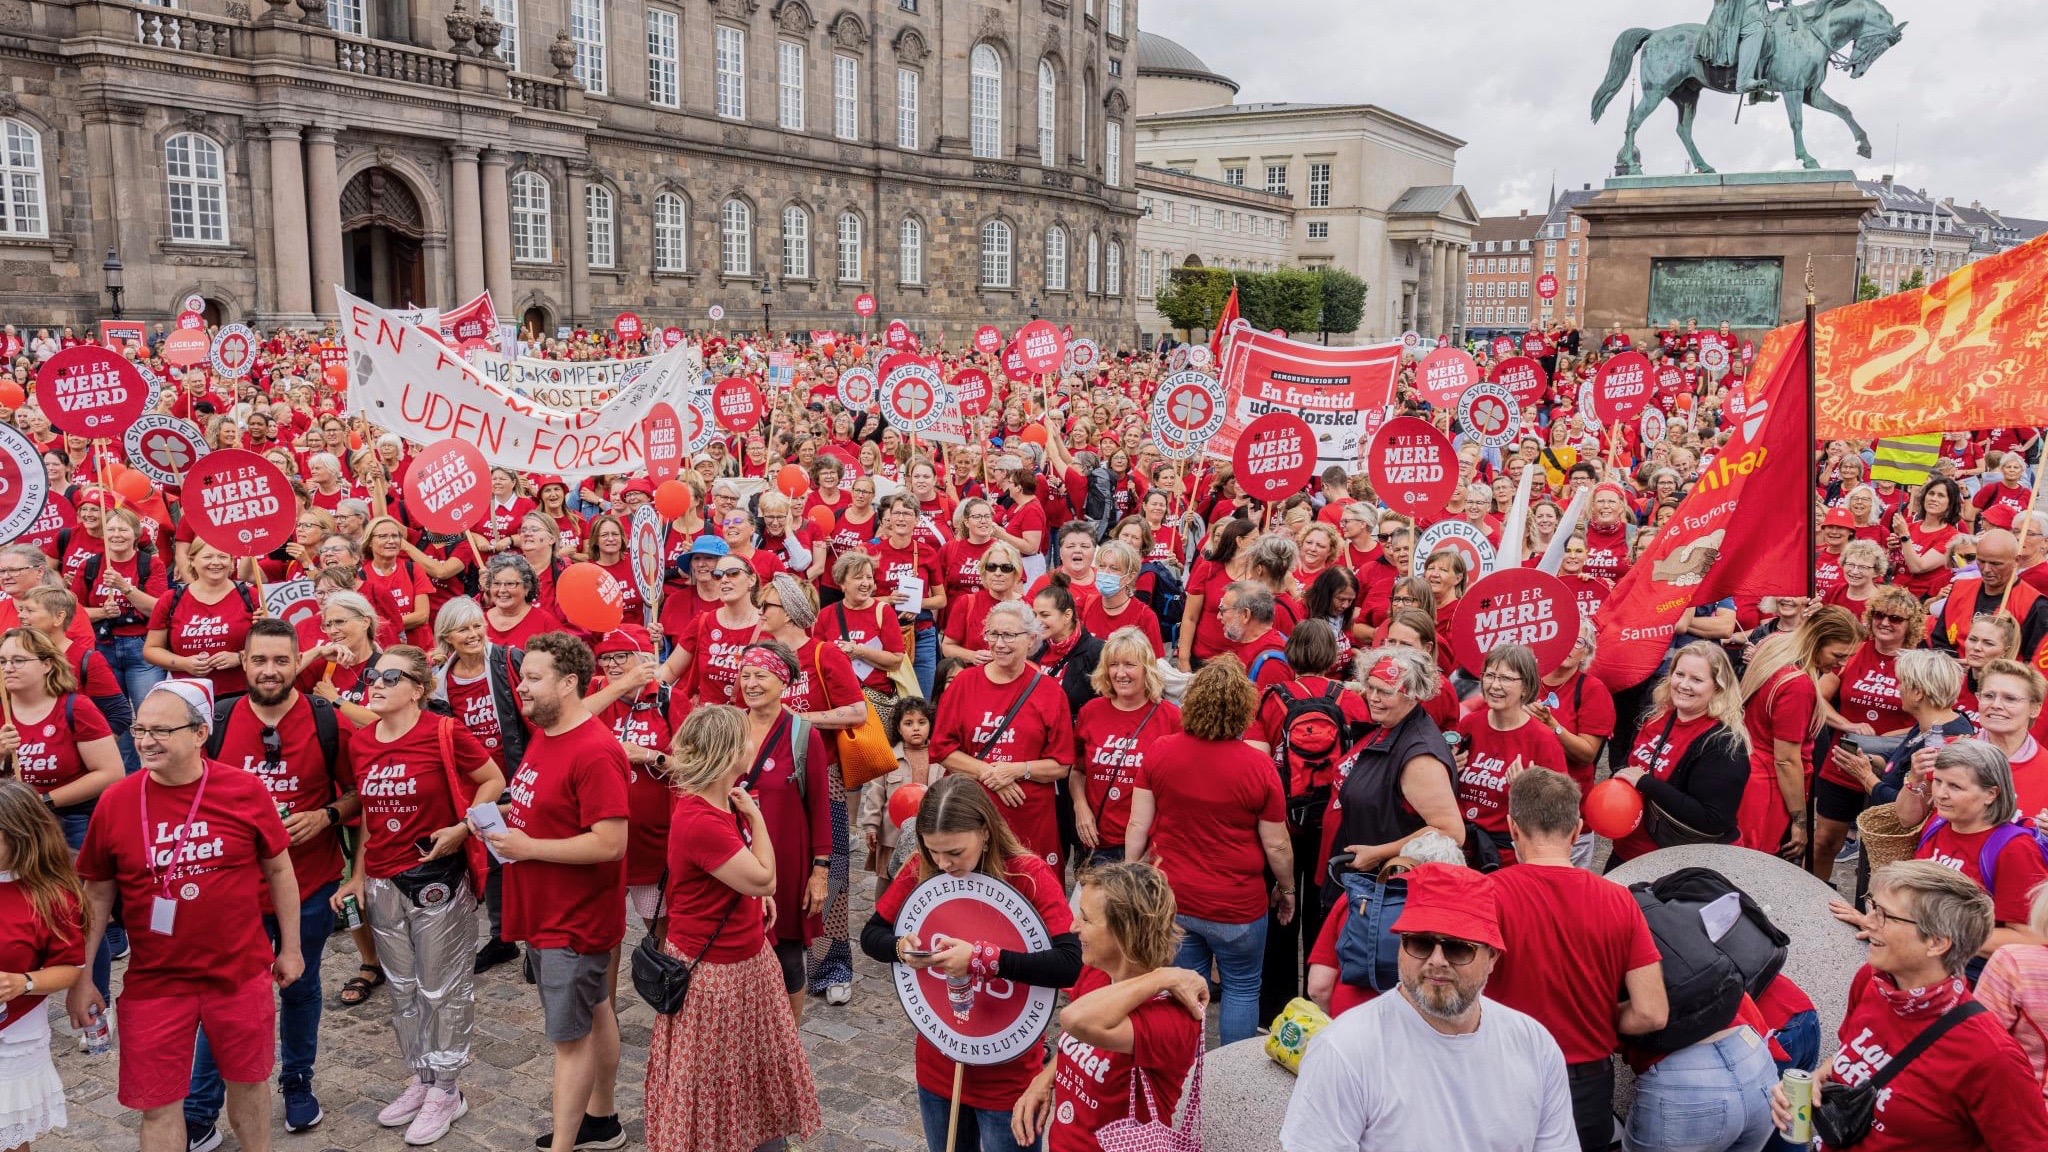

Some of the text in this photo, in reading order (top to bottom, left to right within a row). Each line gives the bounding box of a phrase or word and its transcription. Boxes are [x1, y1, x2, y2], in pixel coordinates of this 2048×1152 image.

[214, 324, 254, 350] SYGEPLEJE
[352, 305, 405, 354] EN
[1025, 334, 1055, 350] MERE
[1027, 344, 1058, 358] VÆRD
[322, 351, 335, 359] ER
[92, 361, 111, 371] ER
[484, 360, 526, 383] HØJ
[1427, 364, 1465, 380] MERE
[1629, 363, 1640, 372] ER
[55, 370, 121, 395] MERE
[1273, 373, 1334, 384] DEMONSTRATION
[1427, 376, 1468, 392] VÆRD
[1500, 369, 1534, 384] MERE
[1605, 370, 1643, 388] MERE
[957, 381, 984, 394] MERE
[957, 389, 986, 401] VÆRD
[1260, 382, 1354, 409] En fremtid
[1604, 383, 1644, 399] VÆRD
[57, 387, 128, 412] VÆRD
[720, 393, 751, 406] MERE
[882, 367, 944, 430] DANSK SYGEPLEJE RAAD
[1155, 373, 1225, 441] DANSK SYGEPLEJE RAAD
[721, 403, 754, 416] VÆRD
[1298, 410, 1359, 425] forskel
[1459, 385, 1519, 446] DANSK SYGEPLEJE RAAD
[400, 383, 649, 471] UDEN FORSK
[664, 419, 672, 427] ER
[1281, 427, 1296, 437] ER
[128, 417, 205, 449] SYGEPLEJE
[650, 428, 675, 443] MERE
[1416, 435, 1431, 445] ER
[650, 444, 676, 460] VÆRD
[1248, 437, 1302, 459] MERE
[1384, 446, 1440, 465] MERE
[128, 447, 175, 484] DANSK
[442, 450, 457, 465] ER
[1248, 453, 1303, 475] VÆRD
[238, 466, 257, 479] ER
[417, 455, 468, 499] MERE
[1384, 465, 1444, 484] VÆRD
[201, 476, 270, 508] MERE
[423, 471, 477, 514] VÆRD
[206, 496, 279, 527] VÆRD
[1425, 524, 1494, 572] SYGEPLEJE
[1521, 587, 1543, 601] ER
[1474, 599, 1553, 633] MERE
[1476, 620, 1558, 653] VÆRD
[792, 682, 809, 696] LØN
[1065, 1065, 1084, 1088] VI ER
[1075, 1086, 1098, 1109] VÆRD
